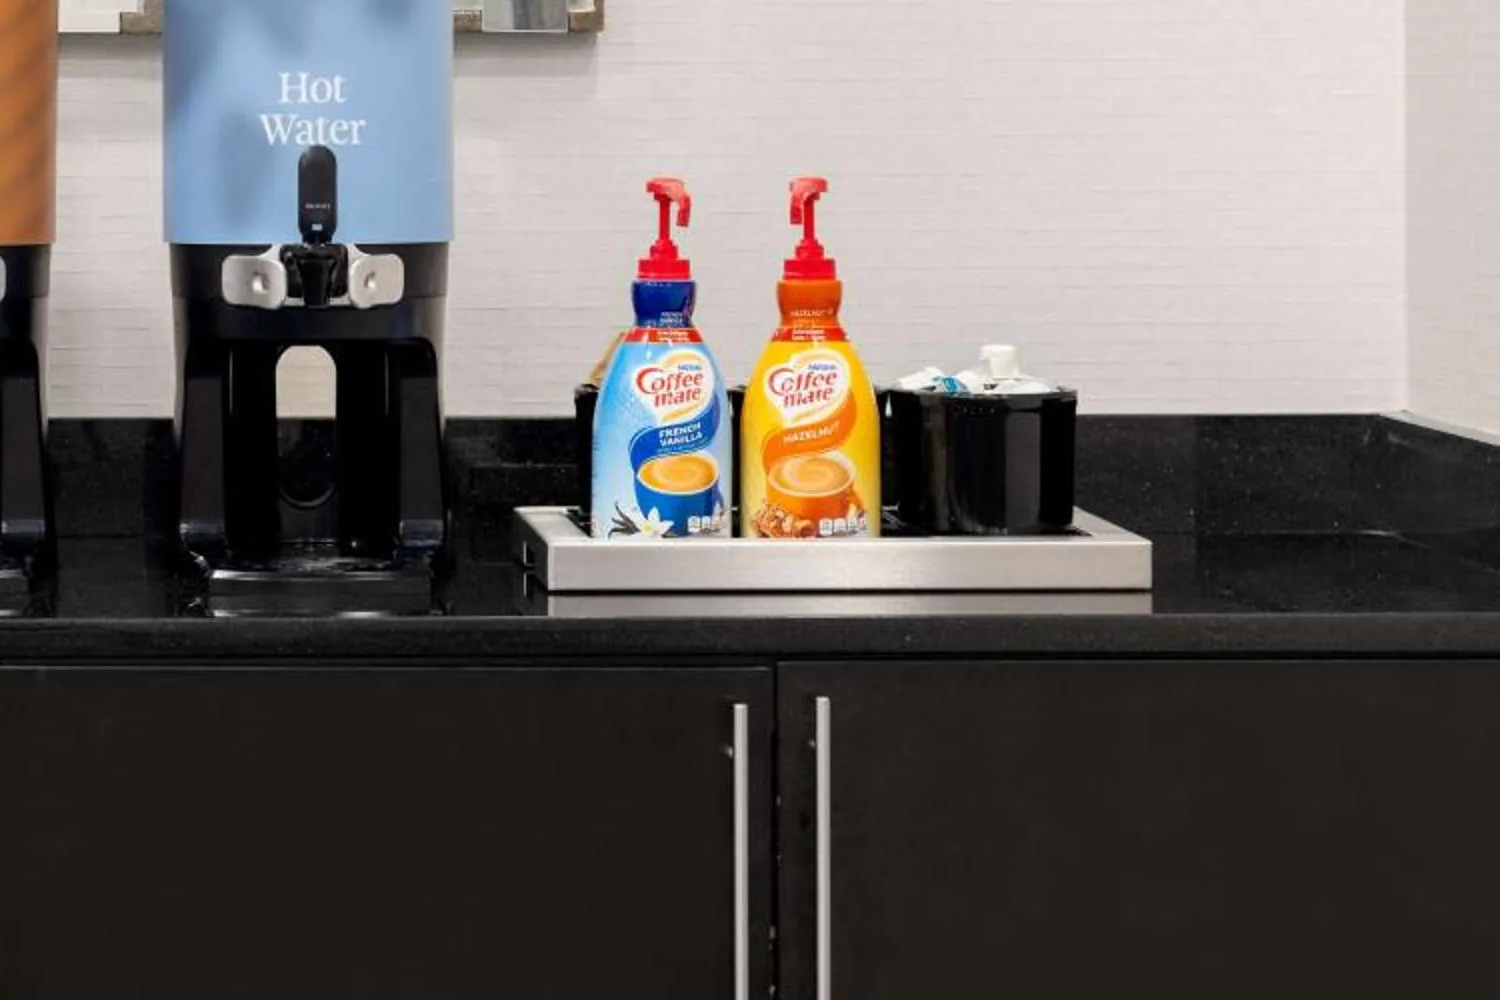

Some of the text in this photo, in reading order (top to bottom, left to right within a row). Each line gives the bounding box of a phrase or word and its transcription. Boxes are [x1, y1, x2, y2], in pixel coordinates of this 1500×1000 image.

[278, 71, 347, 104] Hot
[259, 113, 366, 146] Water
[636, 367, 703, 395] Coffee
[768, 367, 837, 396] Coffee
[653, 387, 701, 407] mate
[783, 387, 833, 408] mate
[659, 421, 701, 439] FRENCH
[659, 431, 703, 447] VANILLA
